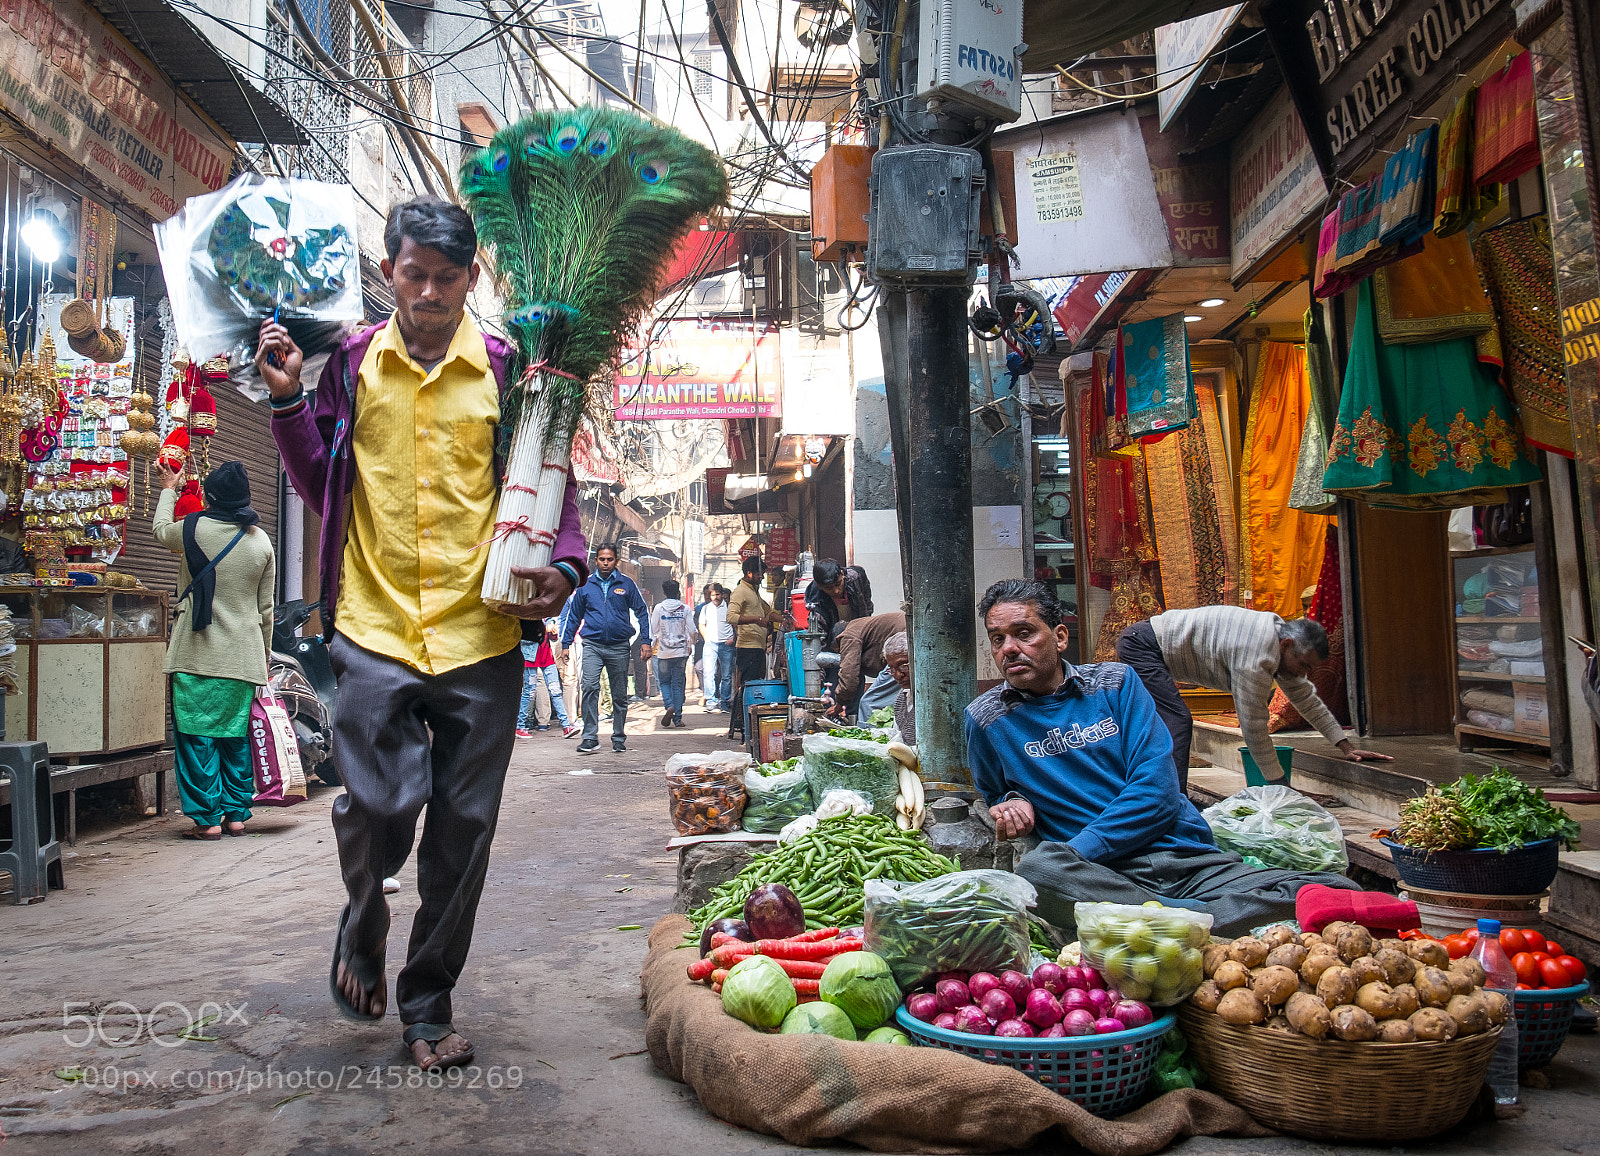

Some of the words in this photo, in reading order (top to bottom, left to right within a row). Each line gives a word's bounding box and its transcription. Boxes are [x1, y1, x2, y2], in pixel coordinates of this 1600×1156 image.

[1326, 49, 1402, 157] SAREE
[116, 128, 163, 180] RETAILER
[135, 92, 226, 192] EMPORIUM
[1036, 167, 1069, 177] SAMSUNG
[1037, 205, 1083, 221] 7835913498
[1168, 200, 1216, 219] एण्ड
[1174, 226, 1220, 251] सन्स
[618, 383, 718, 404] PARANTHE
[722, 381, 777, 404] WALE
[659, 407, 685, 415] Paranthe
[701, 406, 727, 415] Chandni
[750, 405, 766, 414] Dlhi
[1024, 717, 1119, 758] adidas
[252, 719, 272, 785] NOVELTY
